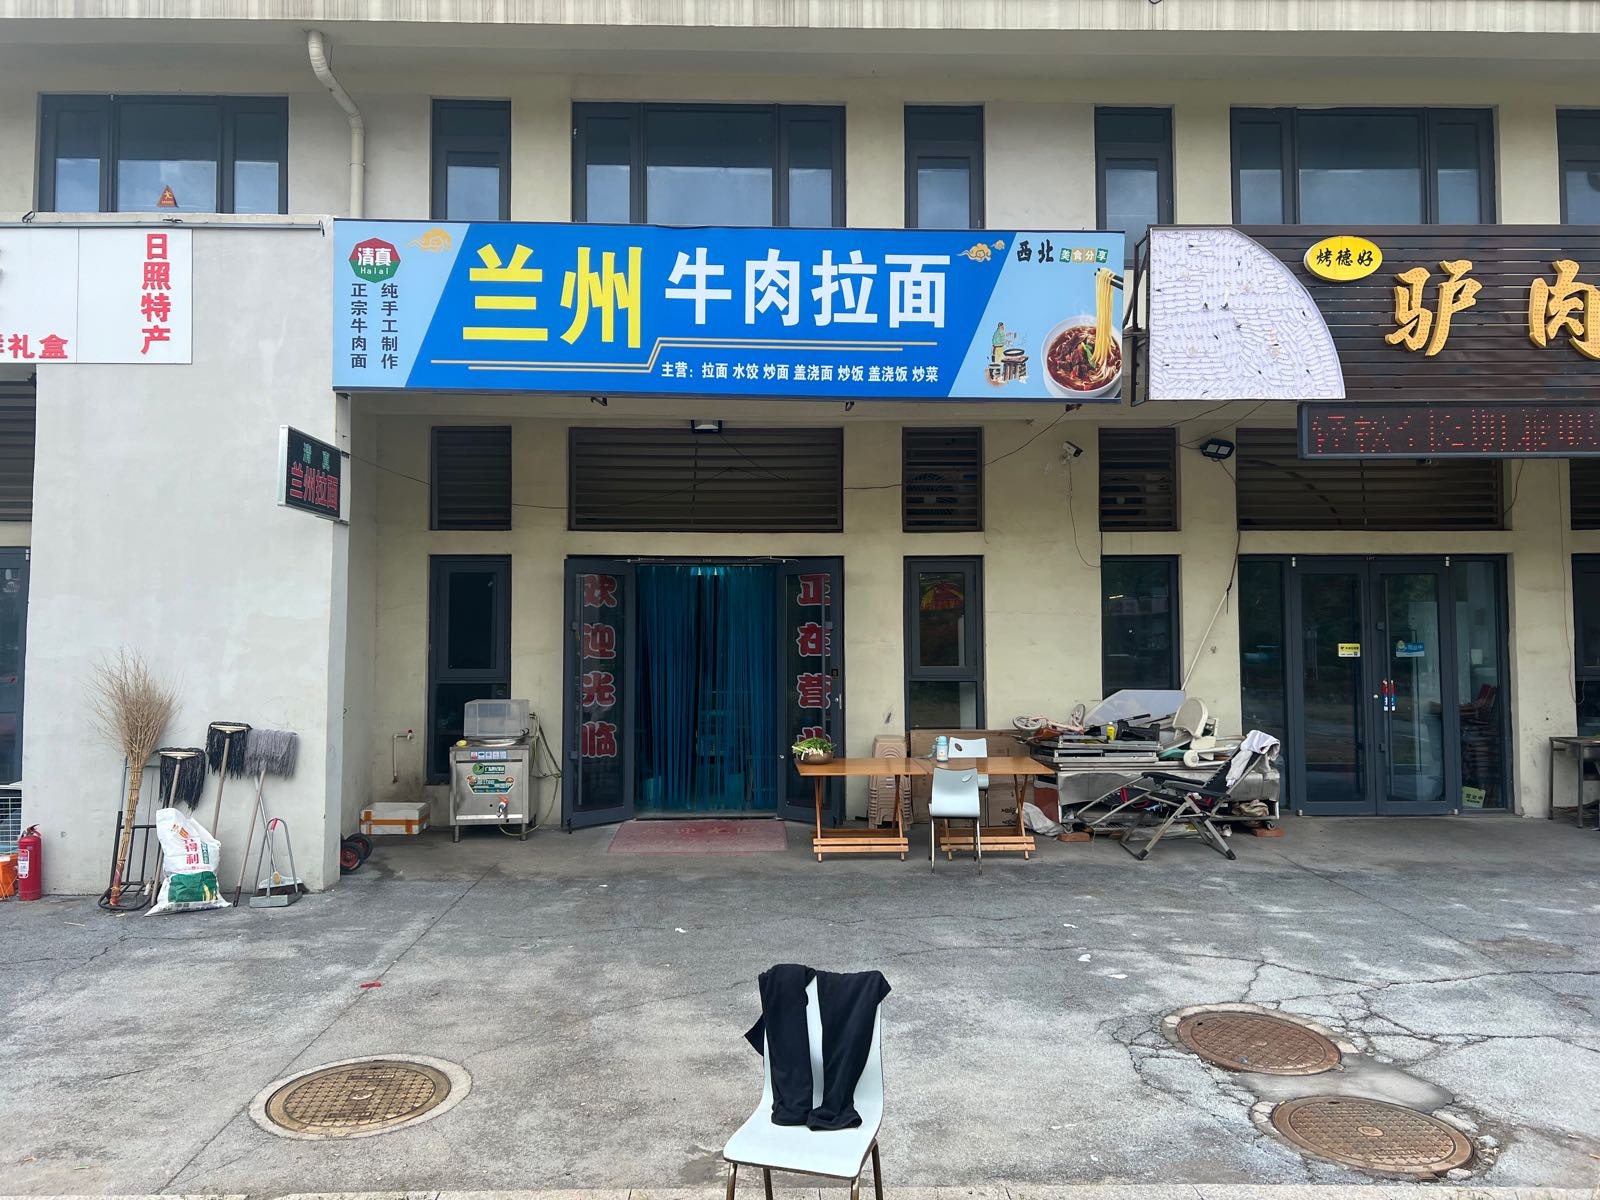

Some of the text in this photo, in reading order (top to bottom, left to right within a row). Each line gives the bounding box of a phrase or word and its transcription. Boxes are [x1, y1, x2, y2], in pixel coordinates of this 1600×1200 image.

[358, 248, 391, 265] 清真
[1017, 239, 1108, 263] 西北 美食分享
[1316, 248, 1374, 268] 烤德好
[141, 233, 171, 354] 日照特产
[463, 244, 950, 348] 兰州 牛肉拉面
[1385, 260, 1600, 360] 驴肉
[0, 334, 68, 359] 礼盒
[350, 283, 368, 368] 正宗牛肉面
[381, 283, 398, 369] 纯手工制作
[702, 362, 728, 379] 拉面
[732, 363, 759, 380] 水饺
[763, 364, 789, 380] 炒面
[793, 365, 833, 381] 盖浇面
[837, 365, 864, 382] 炒饭
[868, 366, 908, 382] 盖浇饭
[912, 367, 939, 382] 炒菜
[290, 461, 338, 510] 兰州拉面
